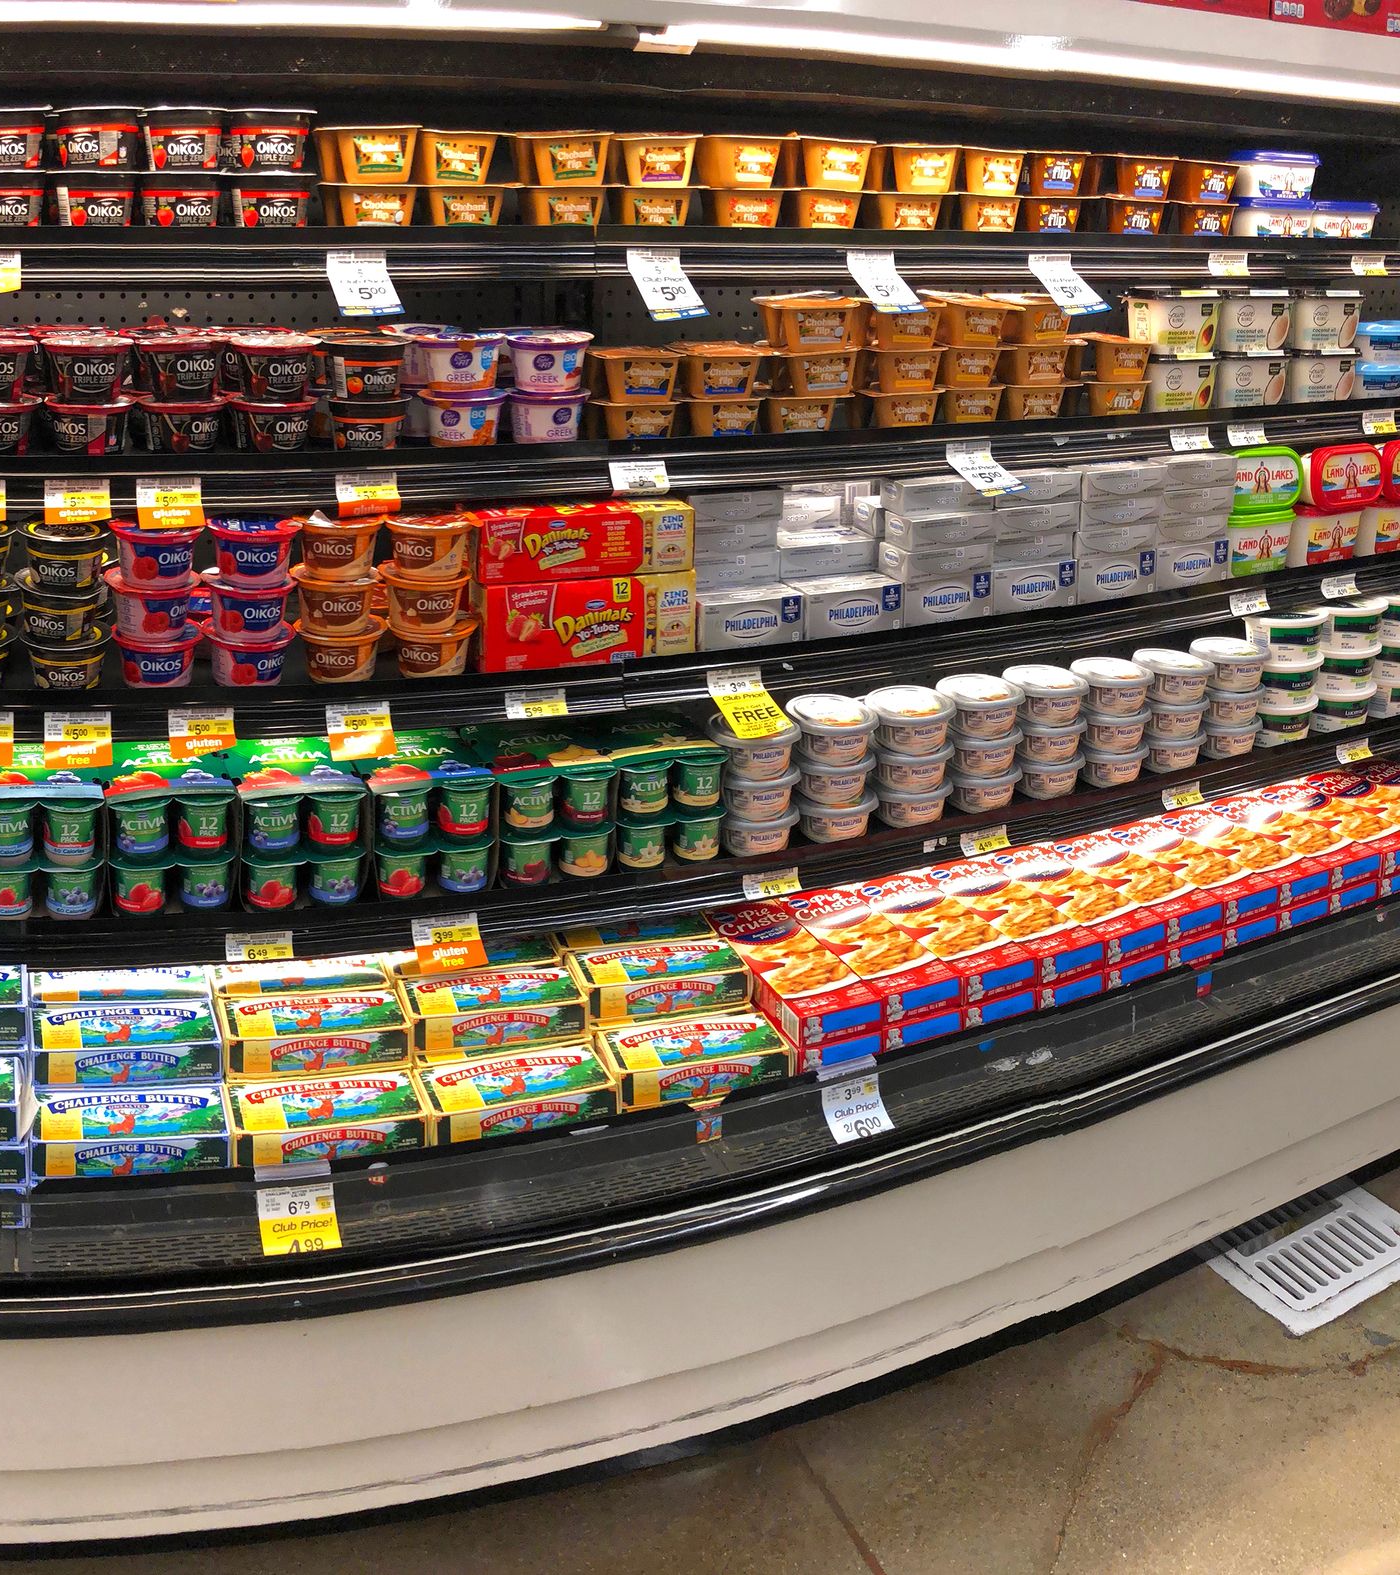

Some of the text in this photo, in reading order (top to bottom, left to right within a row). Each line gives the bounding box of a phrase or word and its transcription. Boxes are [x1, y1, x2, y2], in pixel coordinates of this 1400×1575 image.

[256, 141, 294, 154] OIKOS
[1053, 165, 1071, 181] flip
[260, 205, 296, 218] OIKOS
[269, 362, 308, 376] OIKOS
[472, 409, 485, 419] 80
[1272, 470, 1294, 480] LAKES
[1326, 468, 1344, 479] LAND
[1359, 464, 1377, 476] LAKES
[153, 509, 191, 519] gluten
[161, 517, 184, 526] free
[313, 541, 353, 555] OIKOS
[523, 527, 591, 559] Danimals
[236, 549, 277, 564] OIKOS
[1173, 557, 1212, 573] PHILADELPHIA
[1096, 568, 1138, 585] PHILADELPHIA
[615, 582, 628, 594] 12
[664, 590, 689, 599] FIND
[1012, 579, 1056, 596] PHILADELPHIA
[923, 588, 971, 607] PHILADELPHIA
[829, 603, 880, 621] PHILADELPHIA
[553, 606, 633, 645] Danimals
[725, 614, 778, 632] PHILADELPHIA
[401, 650, 439, 663] OIKOS
[140, 660, 182, 672] OIKOS
[731, 707, 780, 723] FREE
[249, 751, 328, 763] ACTIVIA
[460, 803, 478, 817] 12
[456, 1012, 548, 1032] CHALLENGE BUTTER
[441, 1056, 578, 1083] CHALLENGE BUTTER
[661, 1064, 751, 1086] CHALLENGE BUTTER
[834, 1100, 879, 1120] Club Price!
[284, 1129, 384, 1152] CHALLENGE BUTTER
[272, 1218, 333, 1234] Club Price!
